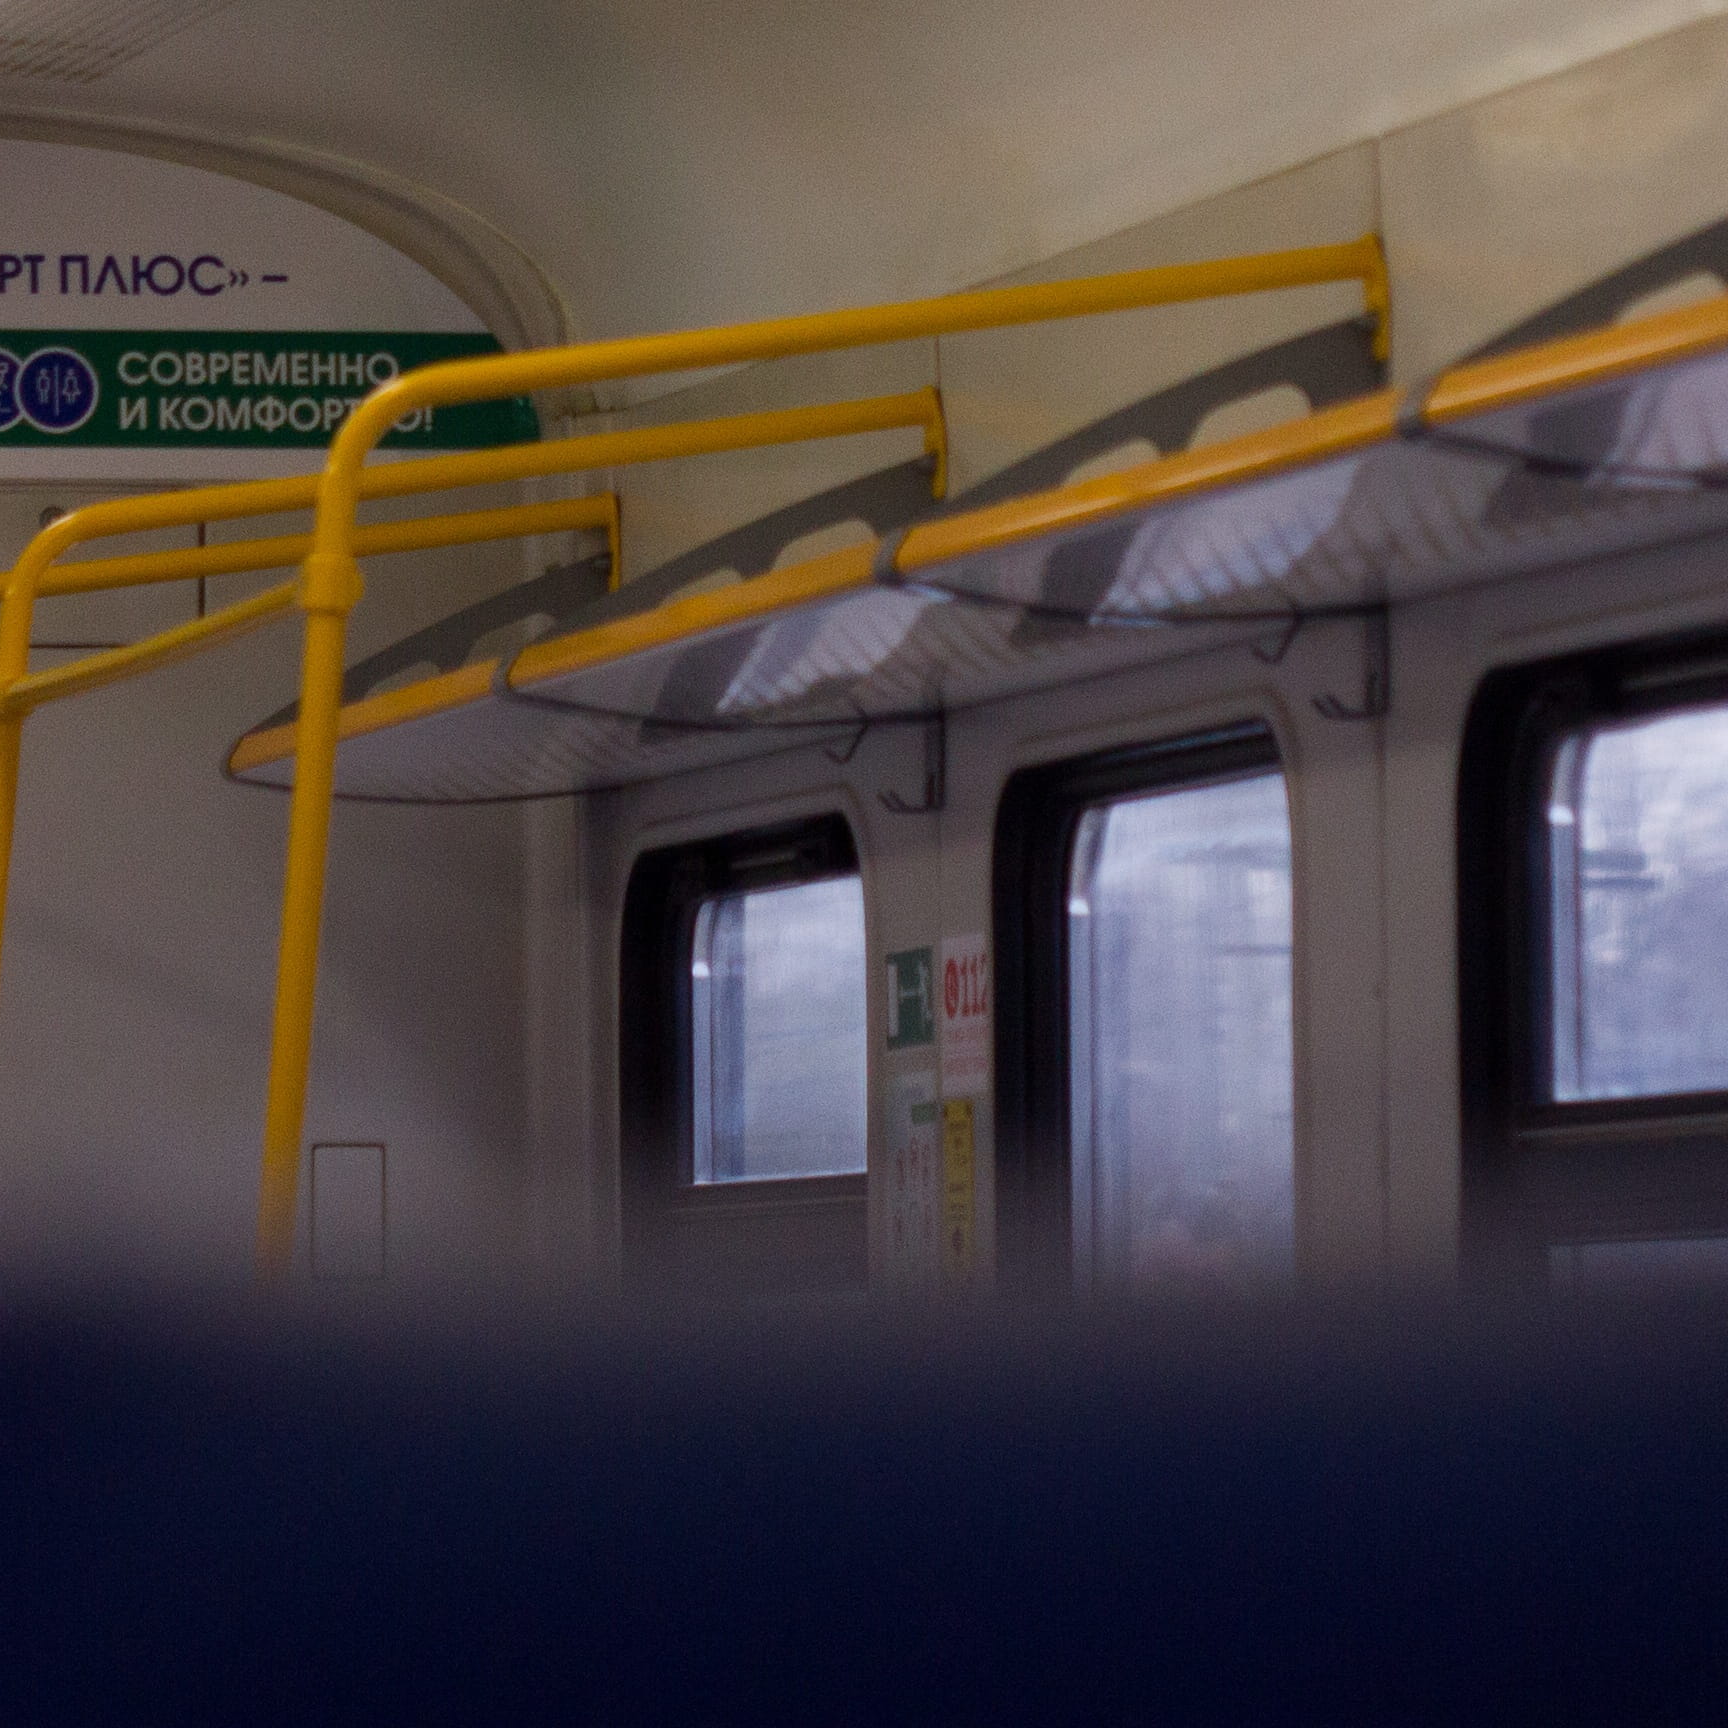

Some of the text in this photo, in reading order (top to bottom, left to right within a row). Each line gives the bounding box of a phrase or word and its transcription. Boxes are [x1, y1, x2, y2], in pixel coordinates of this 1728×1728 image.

[58, 253, 250, 297] ПЛЮС»
[117, 350, 400, 387] СОВРЕМЕННО
[118, 396, 148, 431] И
